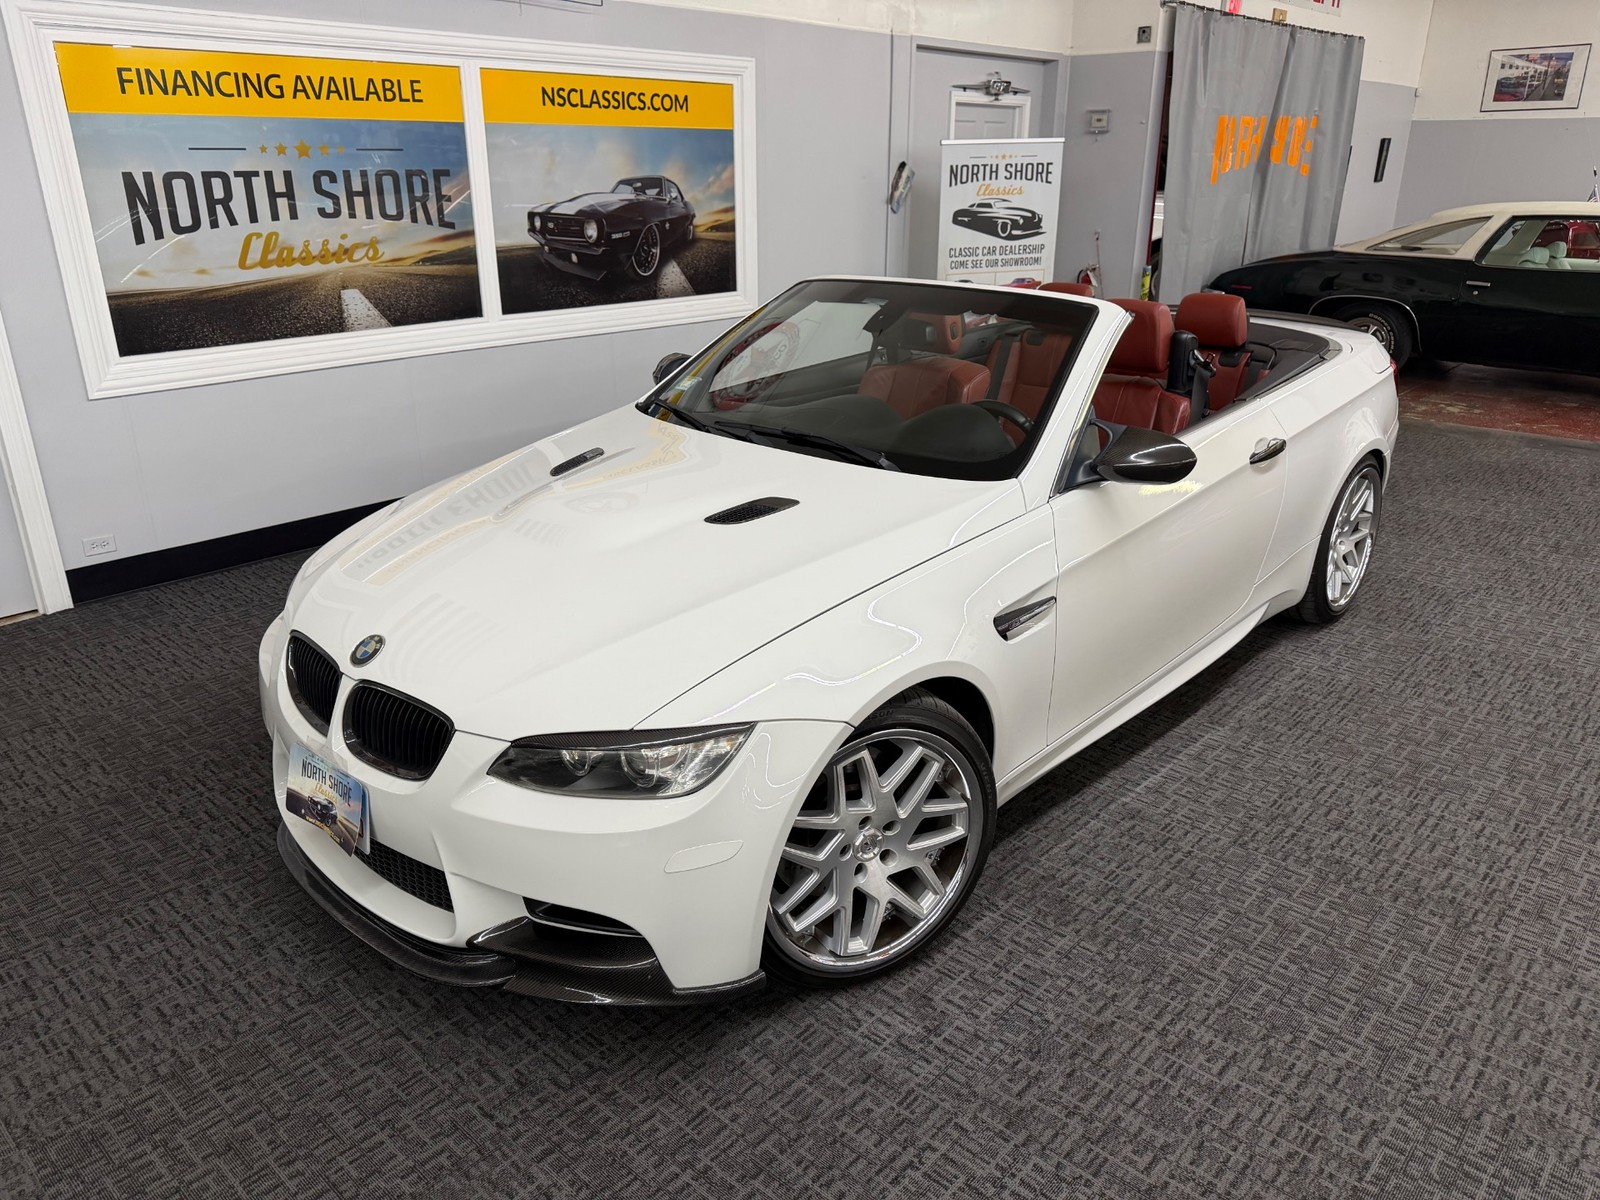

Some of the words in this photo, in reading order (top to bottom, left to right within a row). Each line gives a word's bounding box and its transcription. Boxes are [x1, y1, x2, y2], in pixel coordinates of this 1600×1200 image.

[116, 67, 284, 100] FINANCING
[292, 74, 424, 103] AVAILABLE
[541, 86, 689, 113] NSCLASSICS.COM
[949, 163, 999, 188] NORTH
[1004, 162, 1054, 184] SHORE
[976, 183, 1025, 197] Classics
[121, 170, 299, 246] NORTH
[312, 169, 456, 230] SHORE
[238, 231, 385, 270] Classics
[949, 246, 980, 259] CLASSIC
[982, 245, 997, 256] CAR
[999, 243, 1045, 256] DEALERSHIP
[950, 260, 969, 270] COME
[970, 259, 983, 269] SEE
[985, 258, 999, 268] OUR
[1000, 256, 1042, 267] SHOWROOM!
[301, 758, 327, 785] NORTH
[328, 774, 353, 807] SHORE
